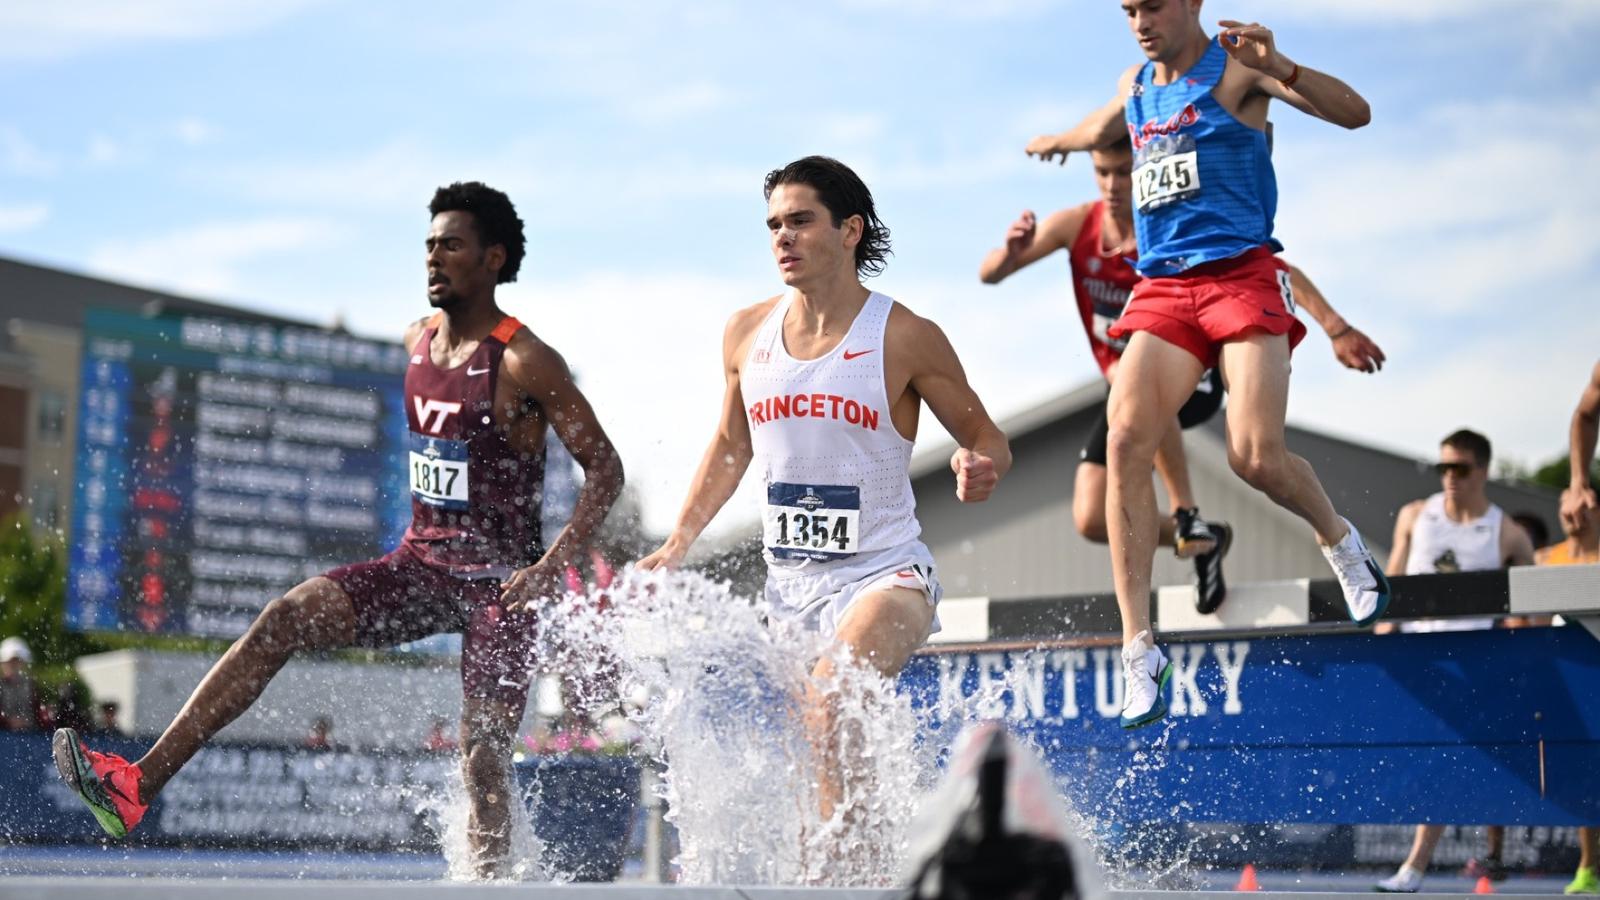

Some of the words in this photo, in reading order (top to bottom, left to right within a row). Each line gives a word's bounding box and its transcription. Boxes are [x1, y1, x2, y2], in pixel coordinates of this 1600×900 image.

[1138, 160, 1192, 202] 1245
[413, 396, 460, 433] VT
[749, 394, 879, 431] PRINCETON
[414, 461, 459, 496] 1817
[775, 512, 850, 550] 1354
[938, 642, 1249, 719] KENTUKY
